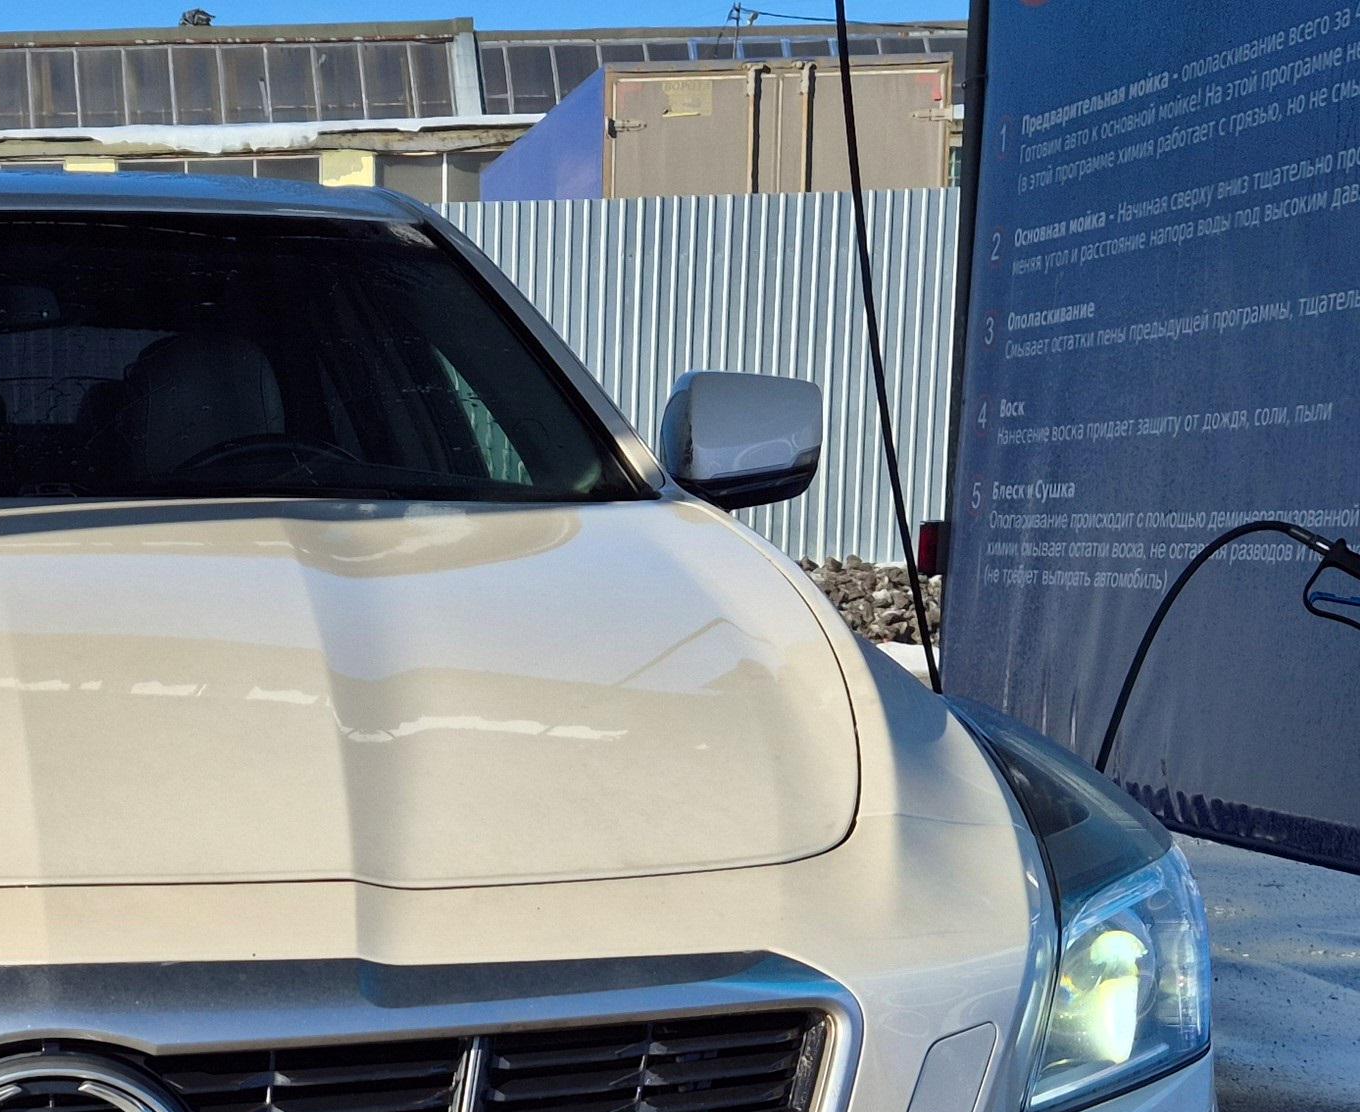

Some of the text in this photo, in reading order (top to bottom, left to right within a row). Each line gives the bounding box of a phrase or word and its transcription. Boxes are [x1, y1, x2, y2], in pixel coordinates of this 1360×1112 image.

[1022, 86, 1125, 137] Предварительная
[1129, 71, 1169, 99] мойка
[1181, 31, 1285, 82] ополаскивание
[1289, 15, 1330, 46] всего
[1333, 8, 1351, 30] за
[1020, 138, 1062, 164] Готовим
[1064, 129, 1088, 150] авто
[1091, 126, 1099, 141] к
[1101, 103, 1156, 139] основной
[1159, 87, 1201, 120] мойке!
[1205, 82, 1222, 107] На
[1226, 69, 1258, 101] этой
[1260, 47, 1343, 93] программе
[1000, 123, 1007, 152] 1
[1018, 173, 1028, 195] (в
[1029, 164, 1053, 190] этой
[1055, 151, 1115, 185] программе
[1117, 139, 1154, 165] химия
[1156, 120, 1216, 160] работает
[1218, 117, 1227, 136] с
[1229, 102, 1283, 136] грязью,
[1287, 94, 1306, 116] но
[1309, 87, 1328, 109] не
[1014, 220, 1067, 248] Основная
[1069, 210, 1106, 234] мойка
[1117, 196, 1168, 223] Начиная
[1170, 184, 1215, 211] сверху
[1217, 175, 1249, 199] вниз
[1253, 154, 1333, 190] тщательно
[991, 232, 1001, 261] 2
[1012, 254, 1041, 276] меняя
[1044, 249, 1069, 274] угол
[1071, 247, 1078, 264] и
[1080, 231, 1146, 266] расстояние
[1149, 221, 1194, 247] напора
[1197, 213, 1232, 236] воды
[1234, 206, 1261, 228] под
[1264, 190, 1328, 222] высоким
[984, 316, 994, 345] 3
[1005, 338, 1050, 360] Смывает
[1051, 332, 1094, 353] остатки
[1096, 326, 1126, 345] пены
[1129, 308, 1209, 345] предыдущей
[1212, 301, 1293, 334] программы,
[1007, 301, 1095, 331] Ополаскивание
[977, 402, 987, 429] 4
[999, 399, 1025, 418] Воск
[1051, 423, 1083, 441] воска
[1086, 418, 1134, 442] придает
[1136, 415, 1181, 438] защиту
[1184, 414, 1200, 432] от
[1201, 409, 1250, 434] дождя,
[1254, 406, 1290, 427] соли,
[1294, 402, 1333, 424] пыли
[971, 482, 981, 509] 5
[992, 481, 1024, 500] Блеск
[1035, 479, 1075, 503] Сушка
[1070, 511, 1134, 533] происходит
[1136, 513, 1144, 528] с
[1145, 511, 1206, 530] помощью
[1068, 542, 1109, 557] остатки
[1149, 541, 1166, 560] не
[1229, 543, 1293, 566] разводов
[1295, 544, 1305, 561] и
[1041, 569, 1090, 591] вытирать
[1093, 567, 1168, 595] автомобиль)
